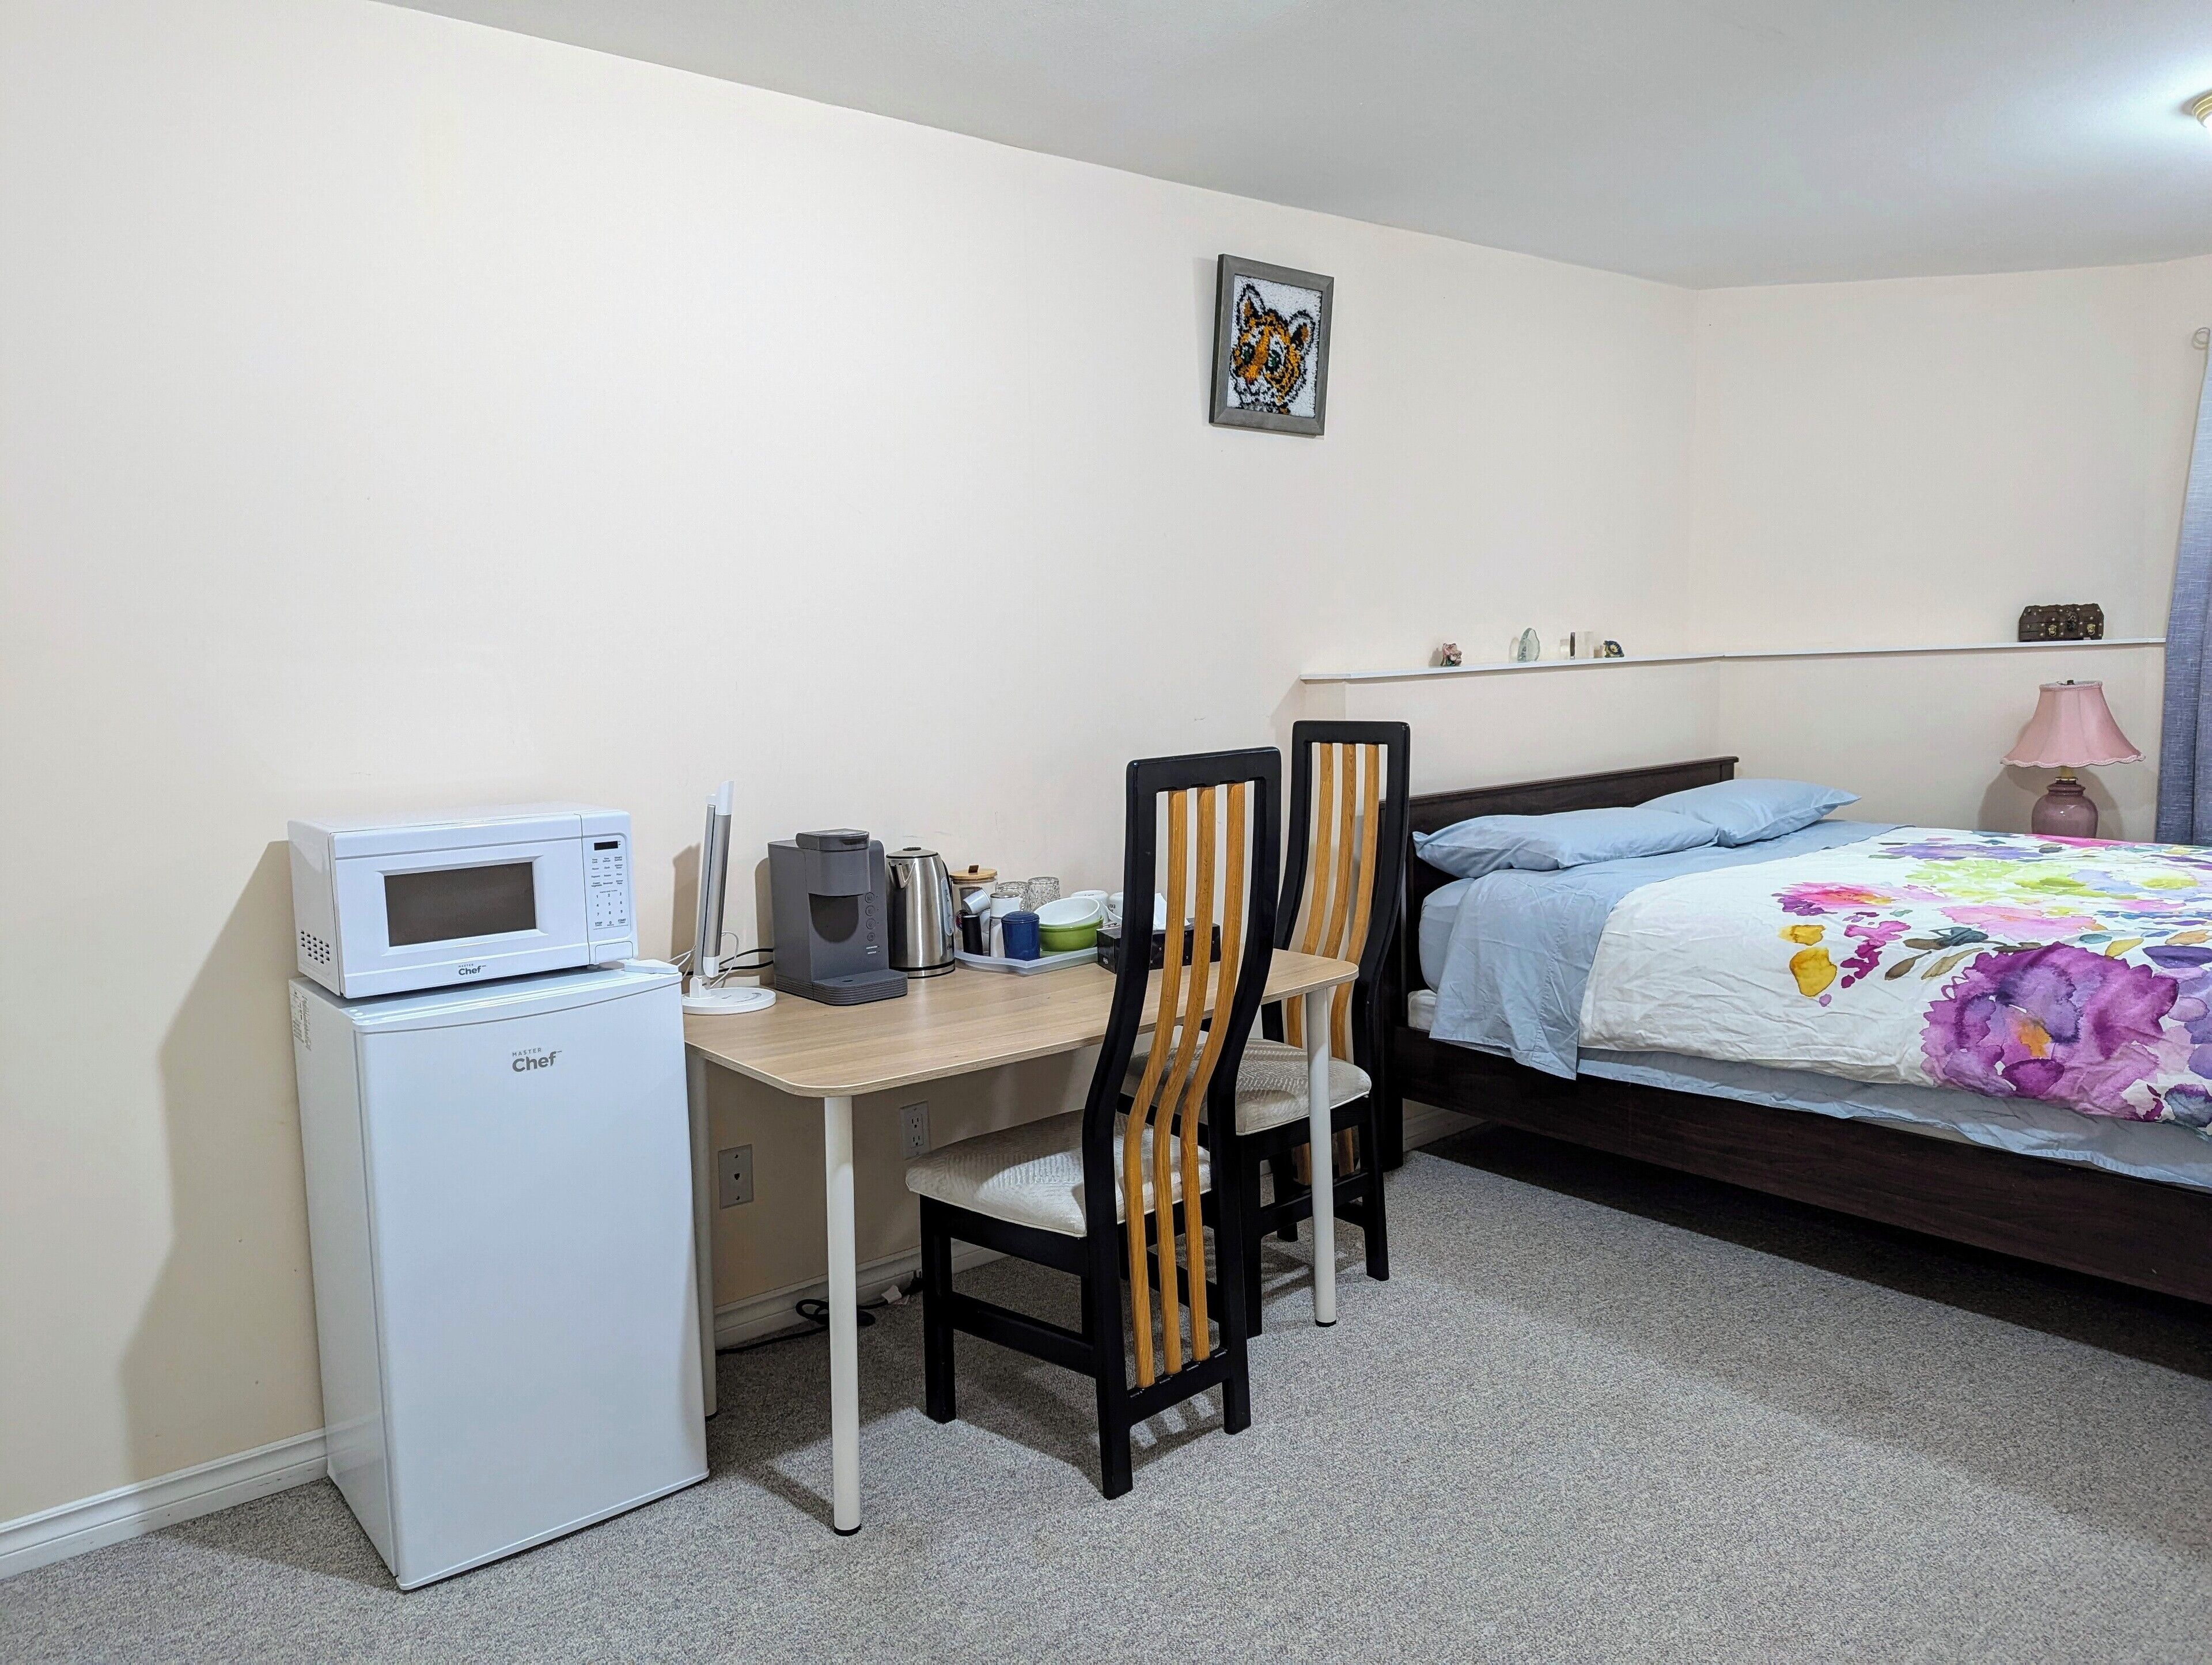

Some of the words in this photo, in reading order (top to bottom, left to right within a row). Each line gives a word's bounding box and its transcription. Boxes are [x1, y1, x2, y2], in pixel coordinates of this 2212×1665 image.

[459, 965, 482, 975] Chef
[512, 1048, 541, 1056] MASTER
[512, 1051, 556, 1072] Chef
